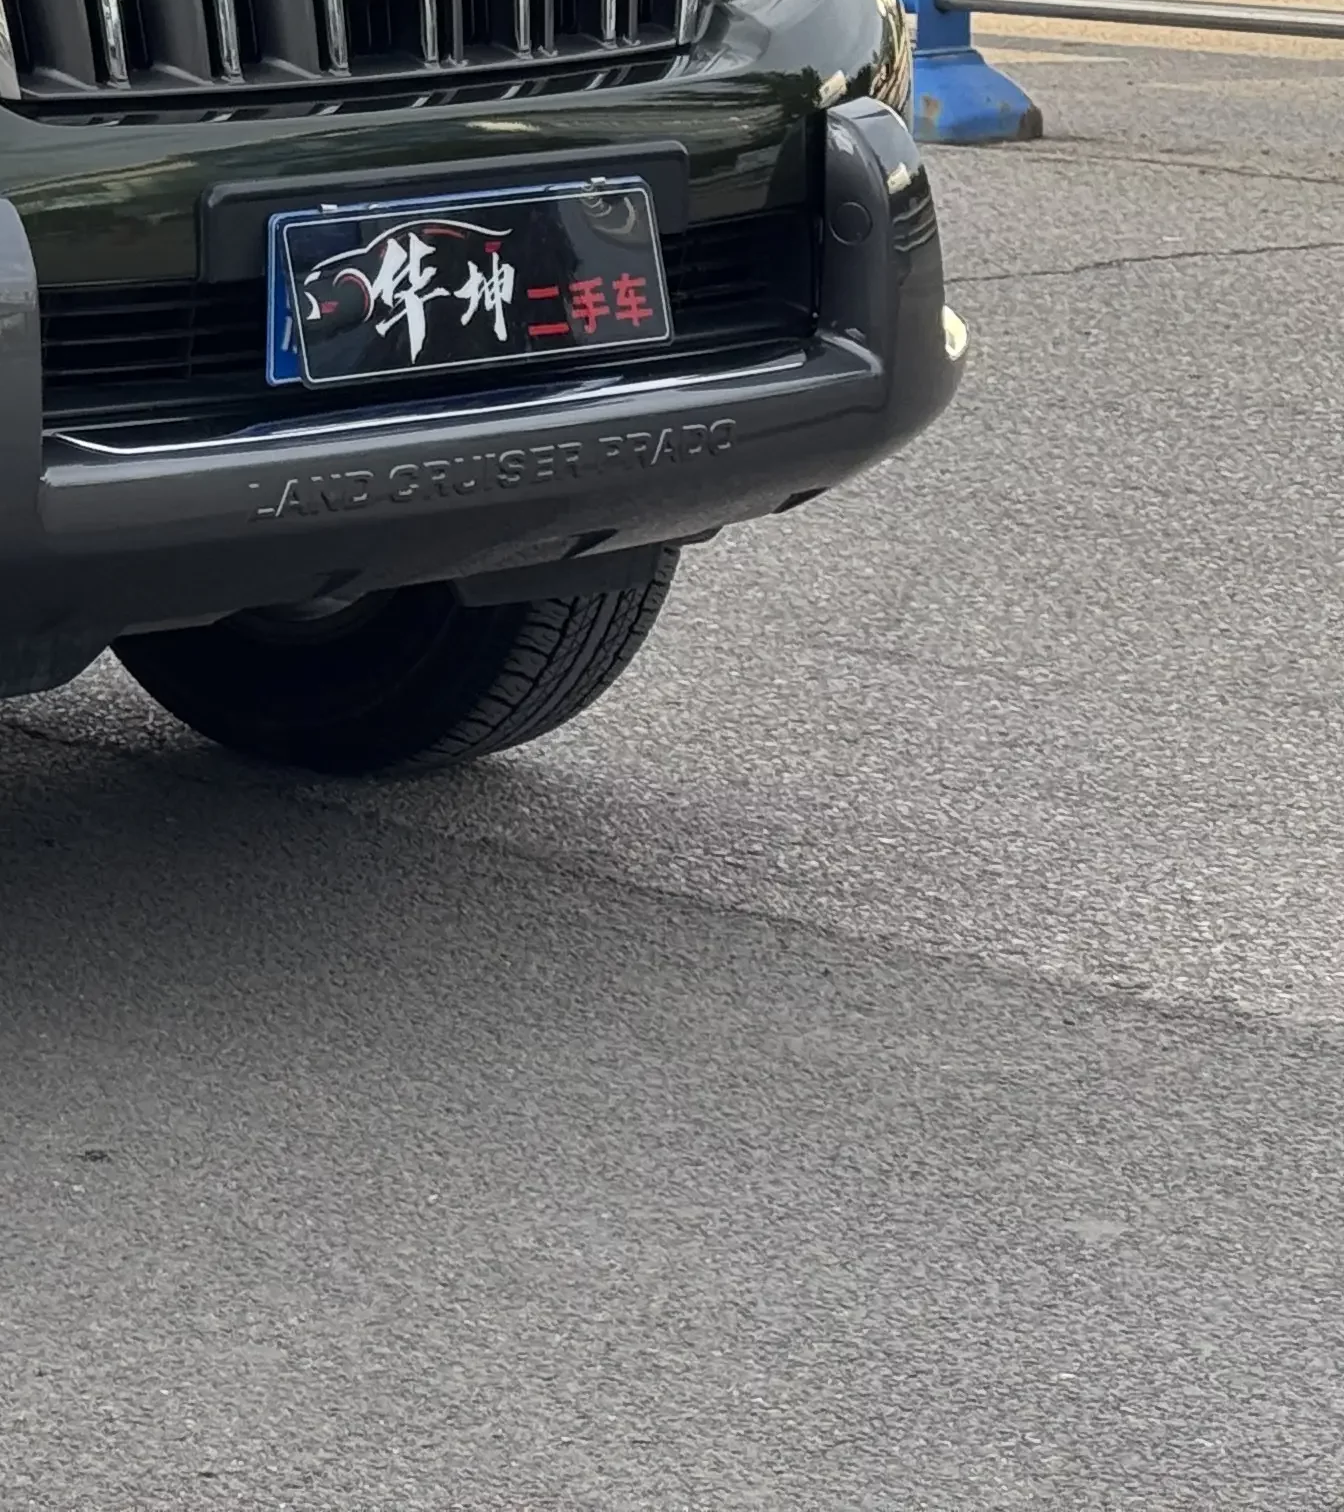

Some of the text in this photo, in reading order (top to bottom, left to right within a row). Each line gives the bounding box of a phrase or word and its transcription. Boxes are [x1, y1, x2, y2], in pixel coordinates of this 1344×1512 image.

[376, 232, 515, 364] 华坤
[527, 273, 654, 336] 二手车
[248, 418, 737, 519] LAND CRUISER PRADO
